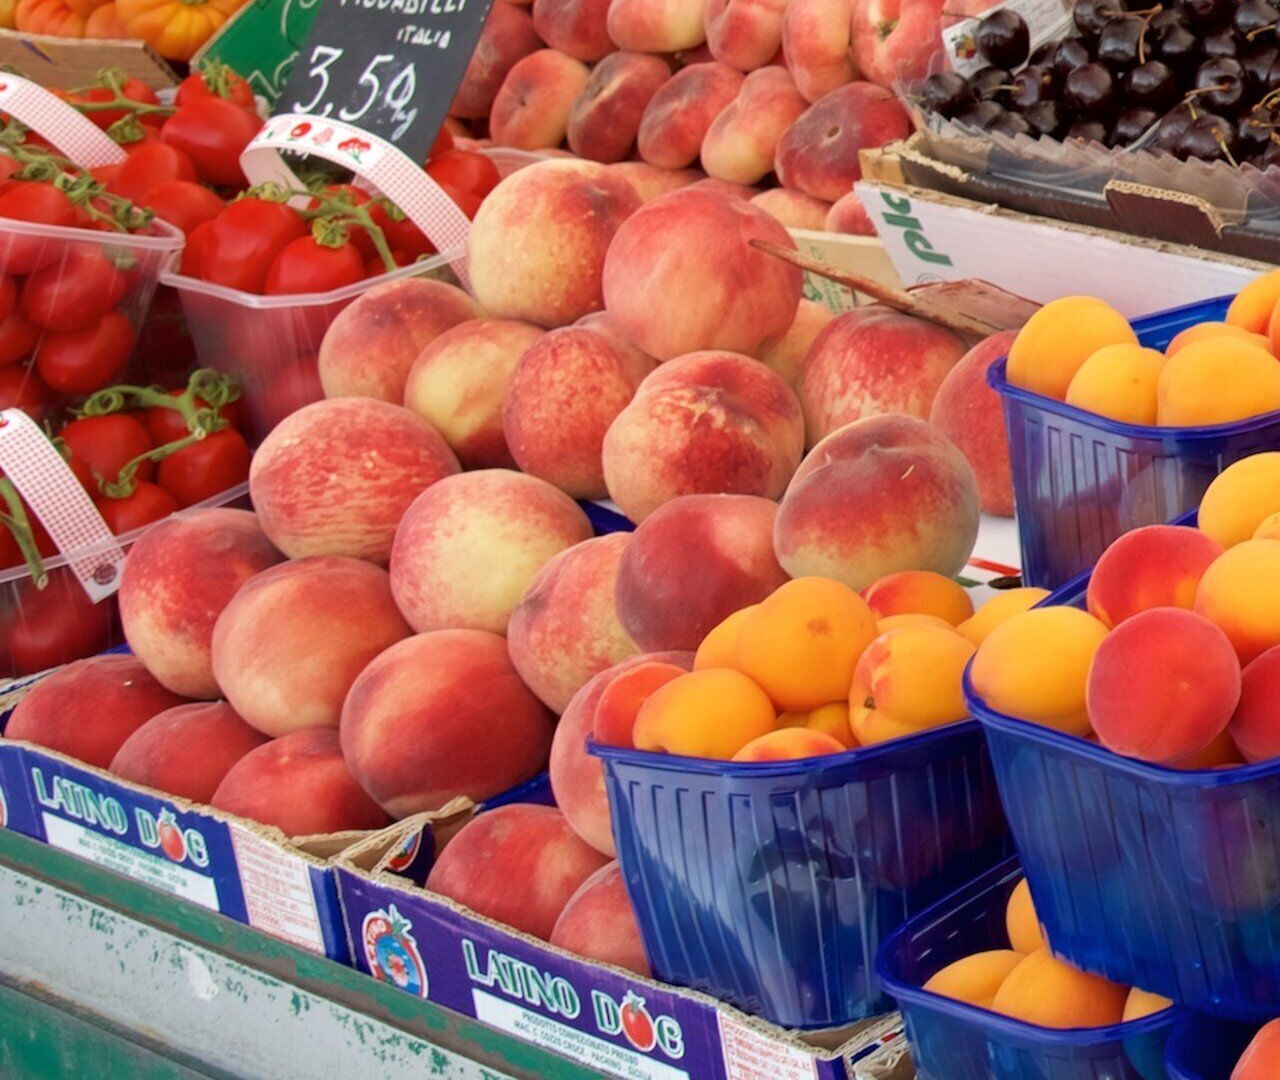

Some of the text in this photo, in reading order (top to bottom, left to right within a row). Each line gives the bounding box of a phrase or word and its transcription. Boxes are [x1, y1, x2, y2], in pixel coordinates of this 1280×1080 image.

[396, 25, 450, 49] ITALIA
[31, 767, 129, 836] LATINO
[462, 938, 581, 1019] LATINO
